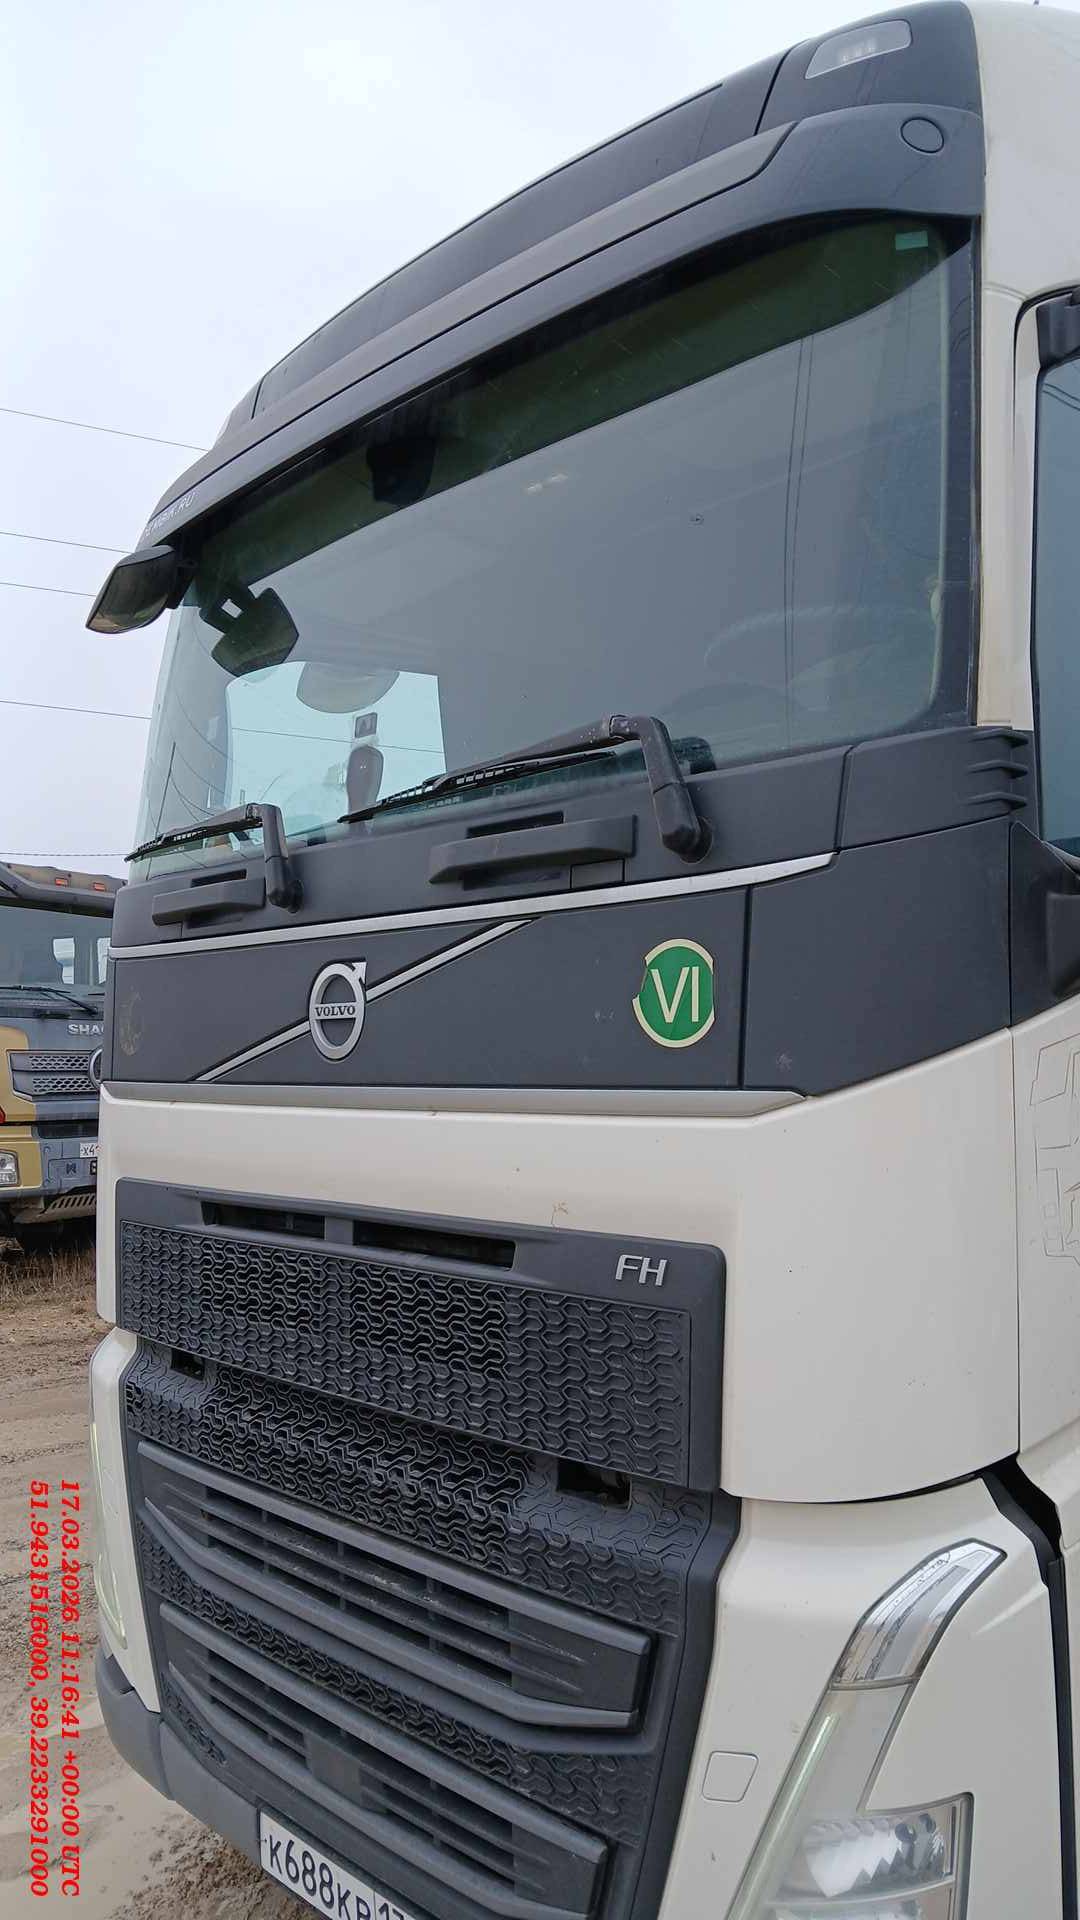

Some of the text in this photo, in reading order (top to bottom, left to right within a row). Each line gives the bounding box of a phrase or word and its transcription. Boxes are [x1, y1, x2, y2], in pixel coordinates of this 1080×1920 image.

[650, 966, 700, 1023] VI
[315, 1006, 356, 1017] VOLVO
[68, 1024, 103, 1035] SHA
[615, 1254, 668, 1286] FH
